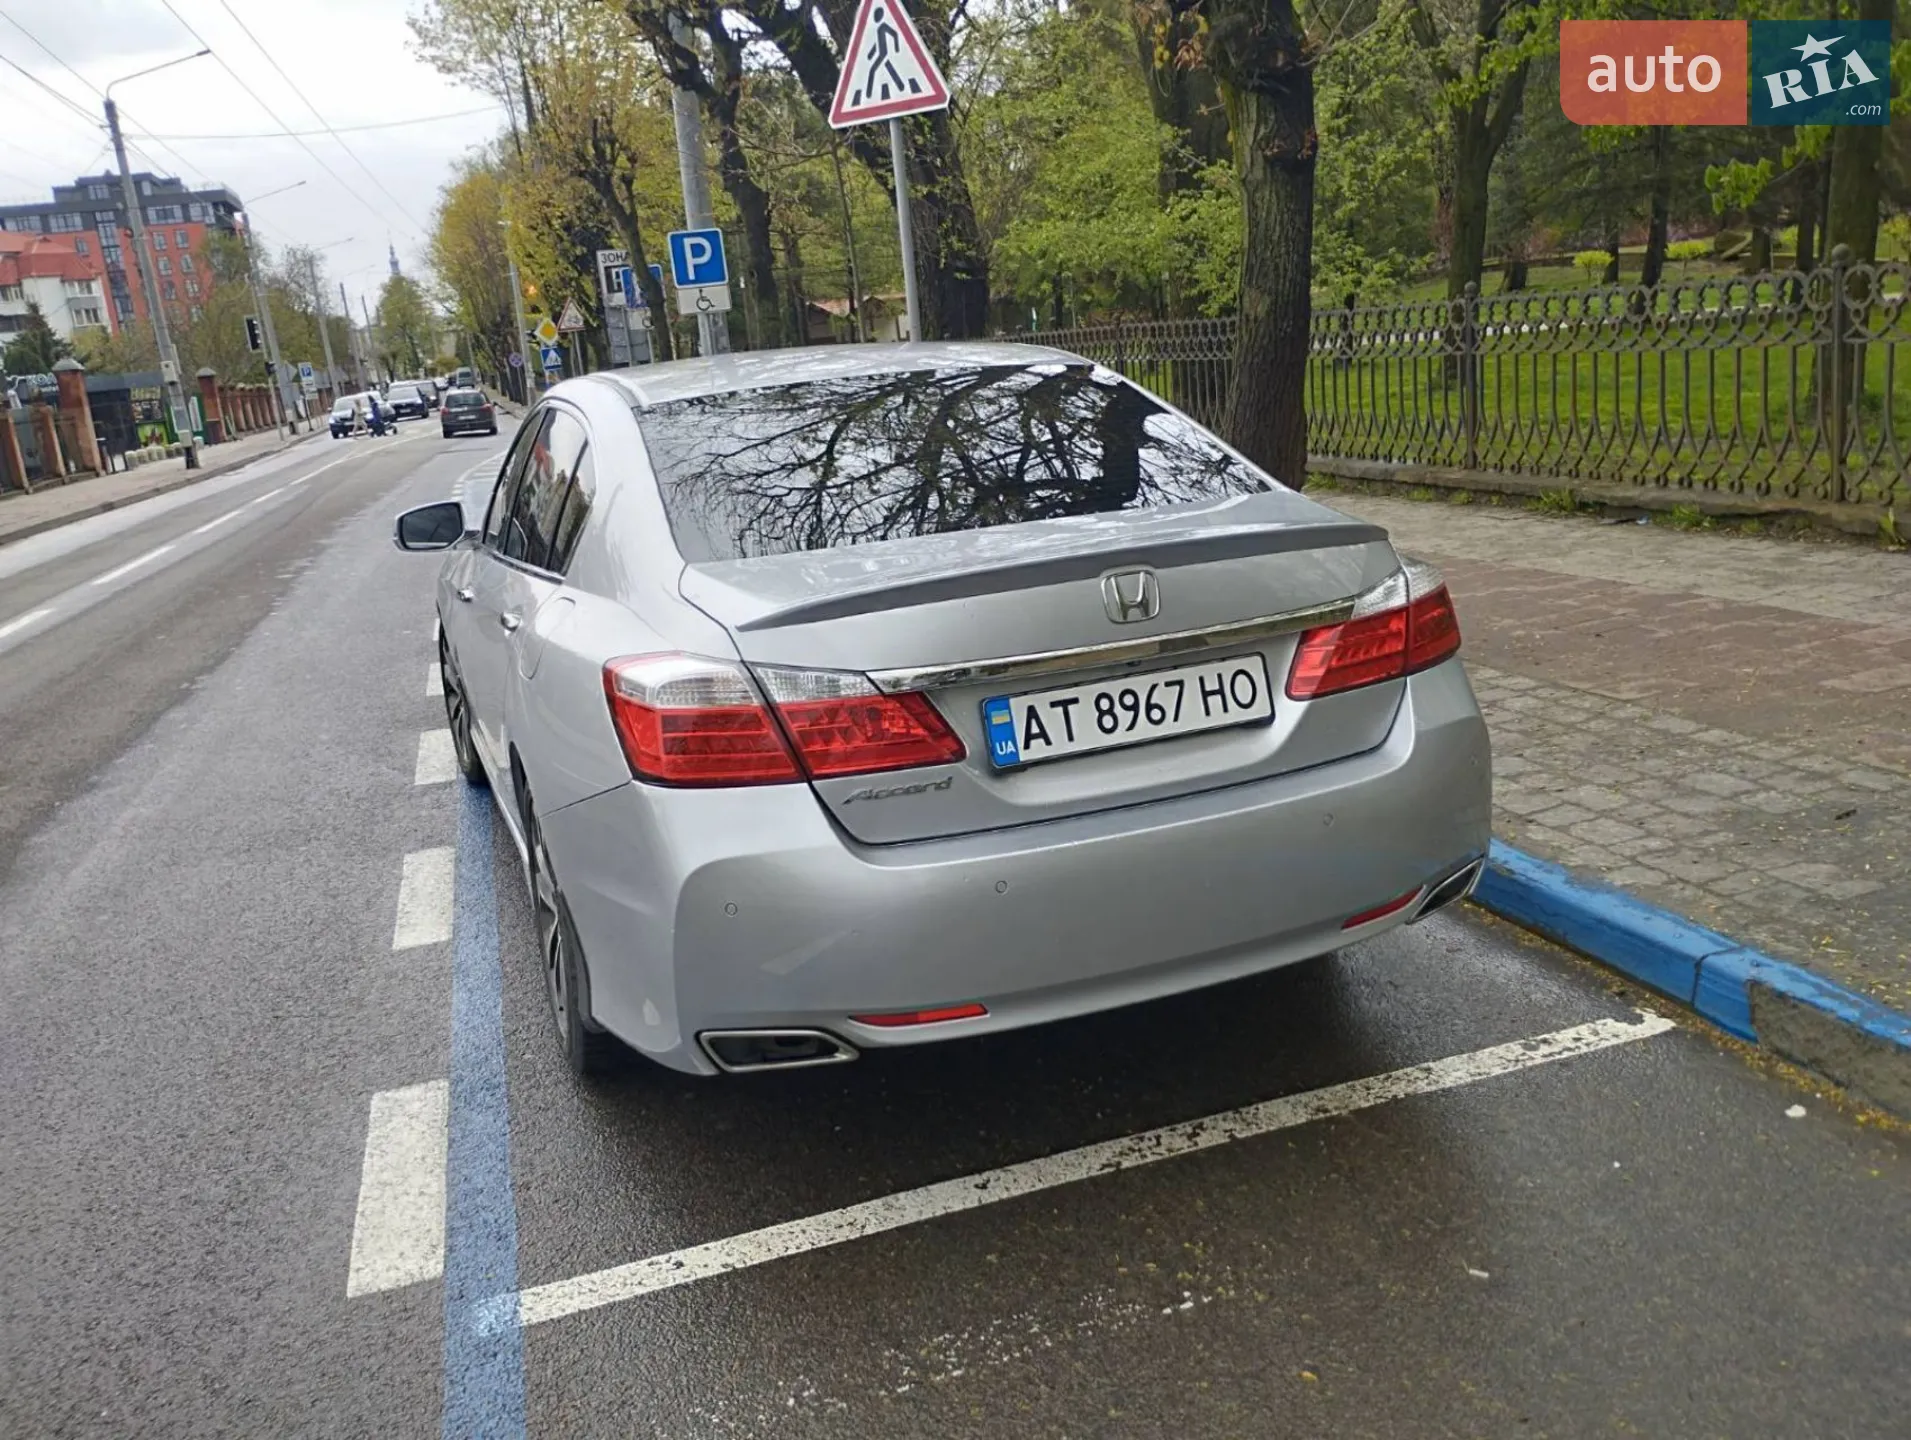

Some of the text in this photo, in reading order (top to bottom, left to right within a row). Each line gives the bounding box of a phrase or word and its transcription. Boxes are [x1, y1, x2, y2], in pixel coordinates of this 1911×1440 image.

[683, 237, 713, 281] P
[1023, 668, 1257, 750] AT 8967 HO
[996, 741, 1016, 756] UA
[842, 776, 953, 806] Accord
